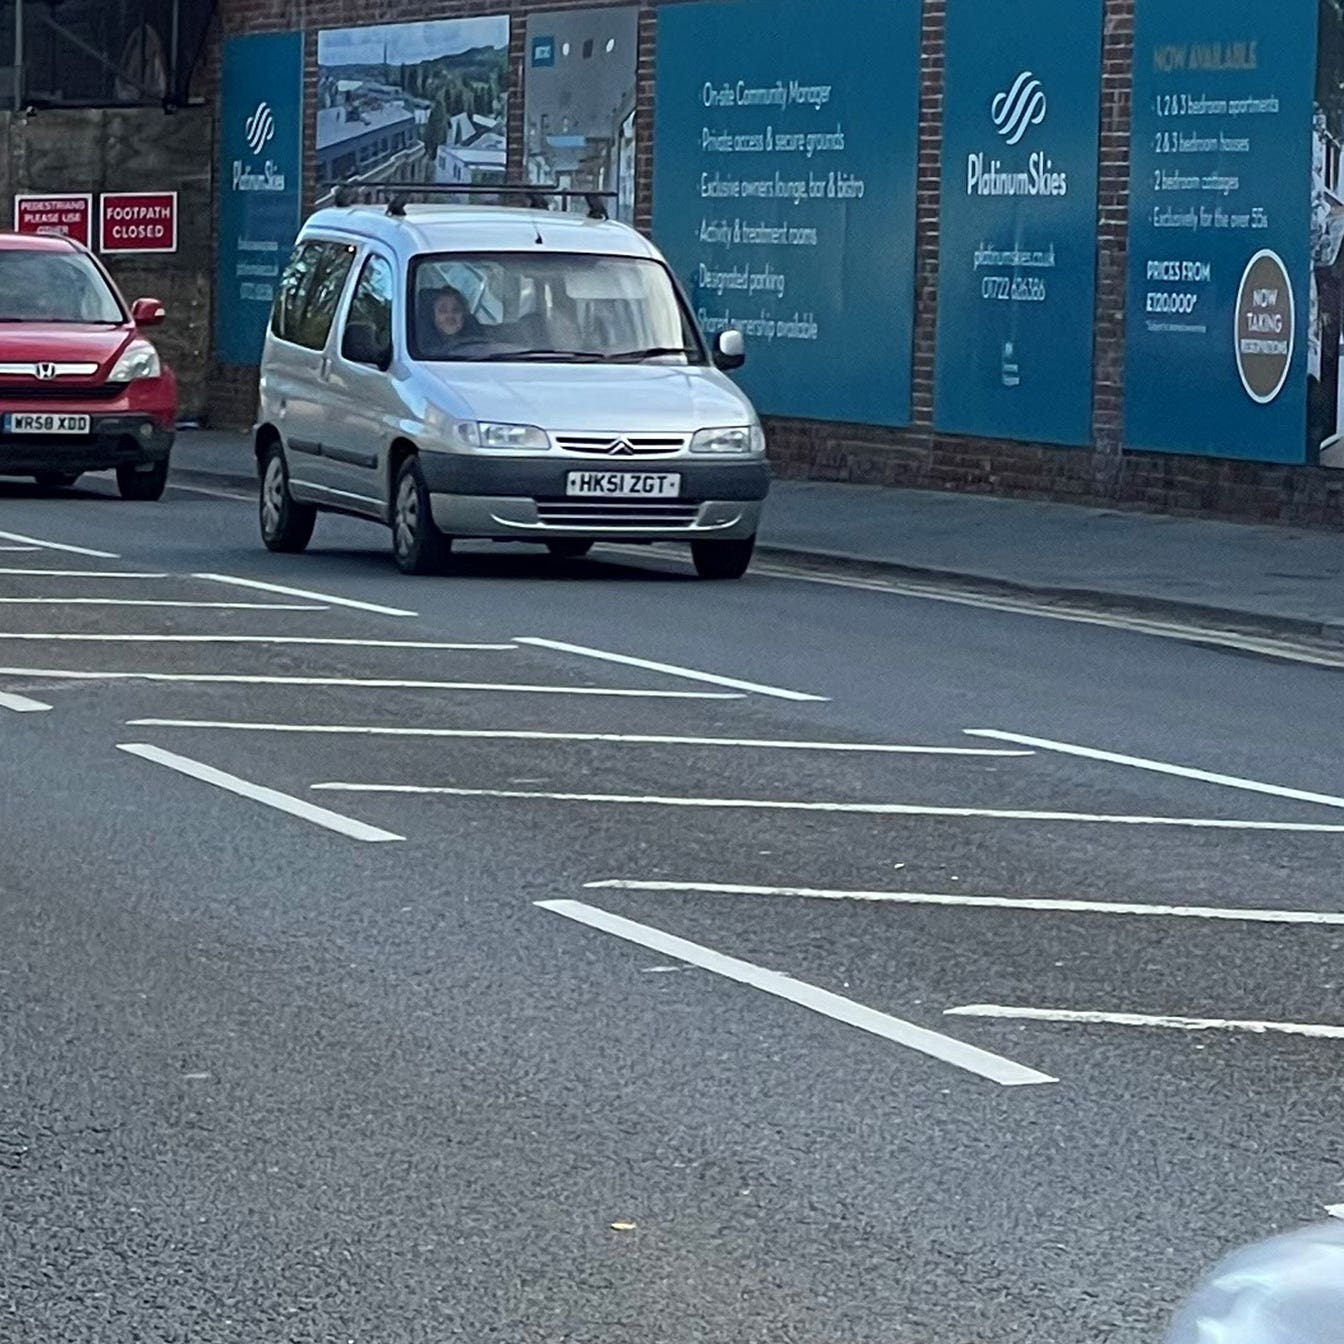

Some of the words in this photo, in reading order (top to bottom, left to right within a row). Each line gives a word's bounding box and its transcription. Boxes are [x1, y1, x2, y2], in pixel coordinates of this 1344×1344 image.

[703, 82, 734, 106] On-site
[736, 80, 786, 111] Community
[788, 80, 831, 110] Manager
[1164, 95, 1170, 116] 2
[1172, 94, 1178, 115] &
[1180, 94, 1187, 114] 3
[1188, 93, 1226, 114] bedroom
[1229, 94, 1279, 118] apartments
[702, 127, 732, 151] Private
[735, 134, 763, 151] access
[766, 126, 773, 151] &
[775, 133, 804, 150] secure
[806, 122, 844, 158] grounds
[1156, 132, 1162, 152] 2
[1163, 132, 1170, 152] &
[1172, 132, 1178, 152] 3
[1179, 130, 1217, 152] bedroom
[1220, 130, 1250, 152] houses
[701, 172, 739, 197] Exclusive
[741, 181, 773, 197] owners
[809, 171, 826, 197] bar
[827, 172, 835, 198] &
[837, 171, 864, 198] bistro
[1154, 169, 1160, 191] 2
[1162, 169, 1200, 190] bedroom
[1202, 171, 1239, 196] cottages
[20, 200, 85, 211] PEDESTRIANS
[106, 206, 171, 220] FOOTPATH
[24, 213, 59, 223] PLEASE
[62, 212, 81, 222] USE
[1154, 206, 1198, 232] Exclusively
[1200, 206, 1212, 227] for
[1215, 207, 1229, 228] the
[1231, 215, 1250, 228] over
[1252, 207, 1268, 228] 55s
[112, 225, 164, 238] CLOSED
[700, 218, 732, 249] Activity
[734, 218, 741, 243] &
[742, 221, 787, 244] treatment
[789, 228, 817, 245] rooms
[700, 263, 749, 295] Designated
[750, 263, 785, 298] parking
[1147, 261, 1180, 280] PRICES
[1182, 261, 1211, 281] FROM
[1253, 289, 1278, 307] NOW
[776, 312, 818, 339] available
[1247, 312, 1282, 333] TAKING
[15, 416, 54, 430] WR58
[58, 417, 87, 430] XDD
[578, 474, 625, 492] HK51
[629, 475, 668, 494] ZGT
